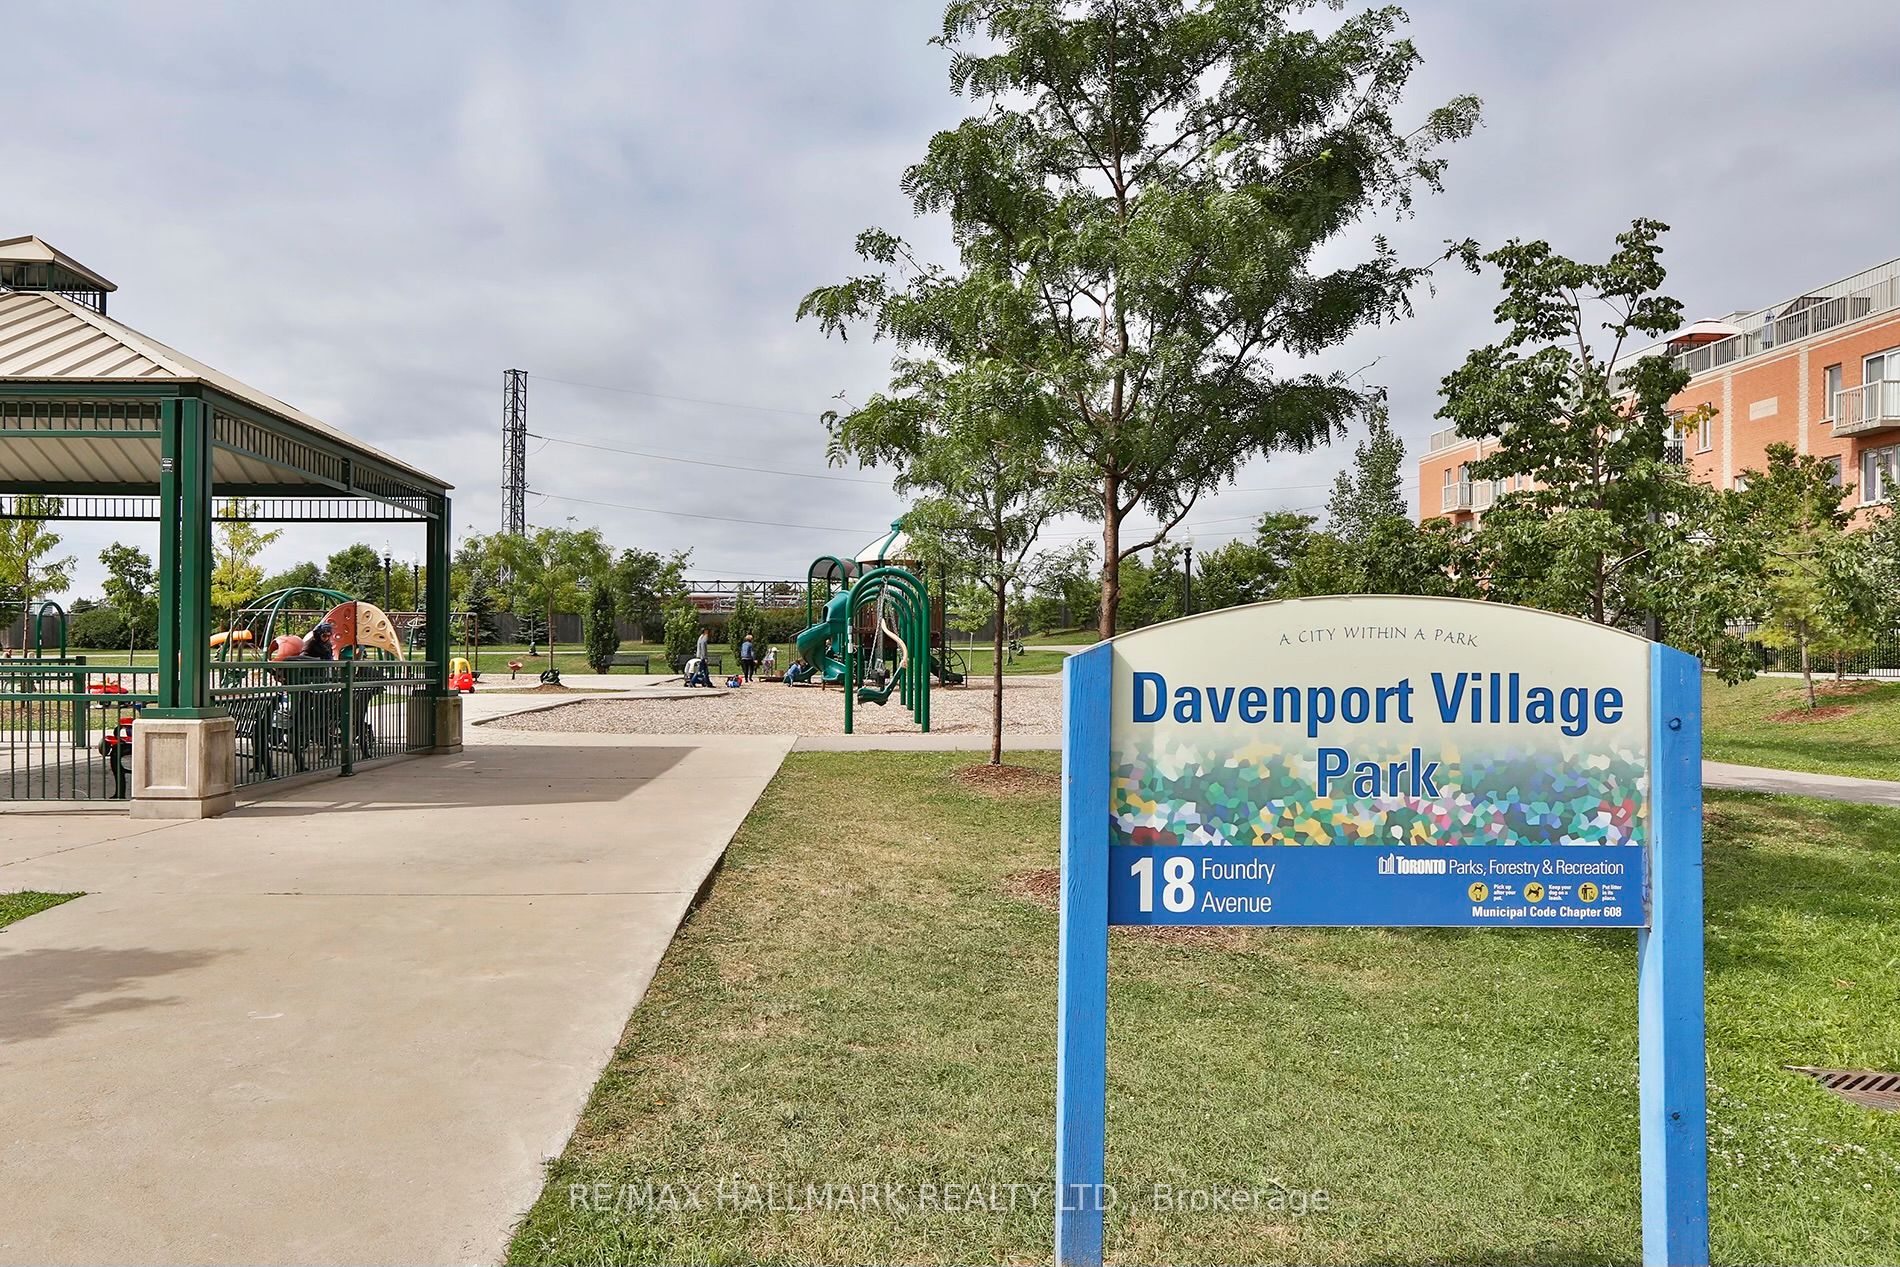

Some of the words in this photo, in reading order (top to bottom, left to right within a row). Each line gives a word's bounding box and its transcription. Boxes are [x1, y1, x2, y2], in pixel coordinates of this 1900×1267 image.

[1279, 633, 1292, 646] A
[1298, 628, 1336, 643] CITY
[1344, 626, 1407, 640] WITHIN
[1414, 628, 1426, 640] A
[1434, 628, 1478, 648] PARK
[1131, 671, 1415, 739] Davenport
[1430, 671, 1625, 738] Village
[1316, 746, 1440, 800] Park
[1202, 858, 1276, 885] Foundry
[1396, 855, 1447, 875] TORONTO
[1449, 859, 1487, 877] Parks,
[1489, 859, 1541, 879] Forestry
[1542, 859, 1553, 875] &
[1555, 859, 1624, 875] Recreation
[1130, 856, 1196, 913] 18
[1201, 891, 1272, 913] Avenue
[1471, 905, 1527, 920] Municipal
[1529, 906, 1557, 918] Code
[1559, 906, 1601, 920] Chapter
[1603, 906, 1622, 918] 608
